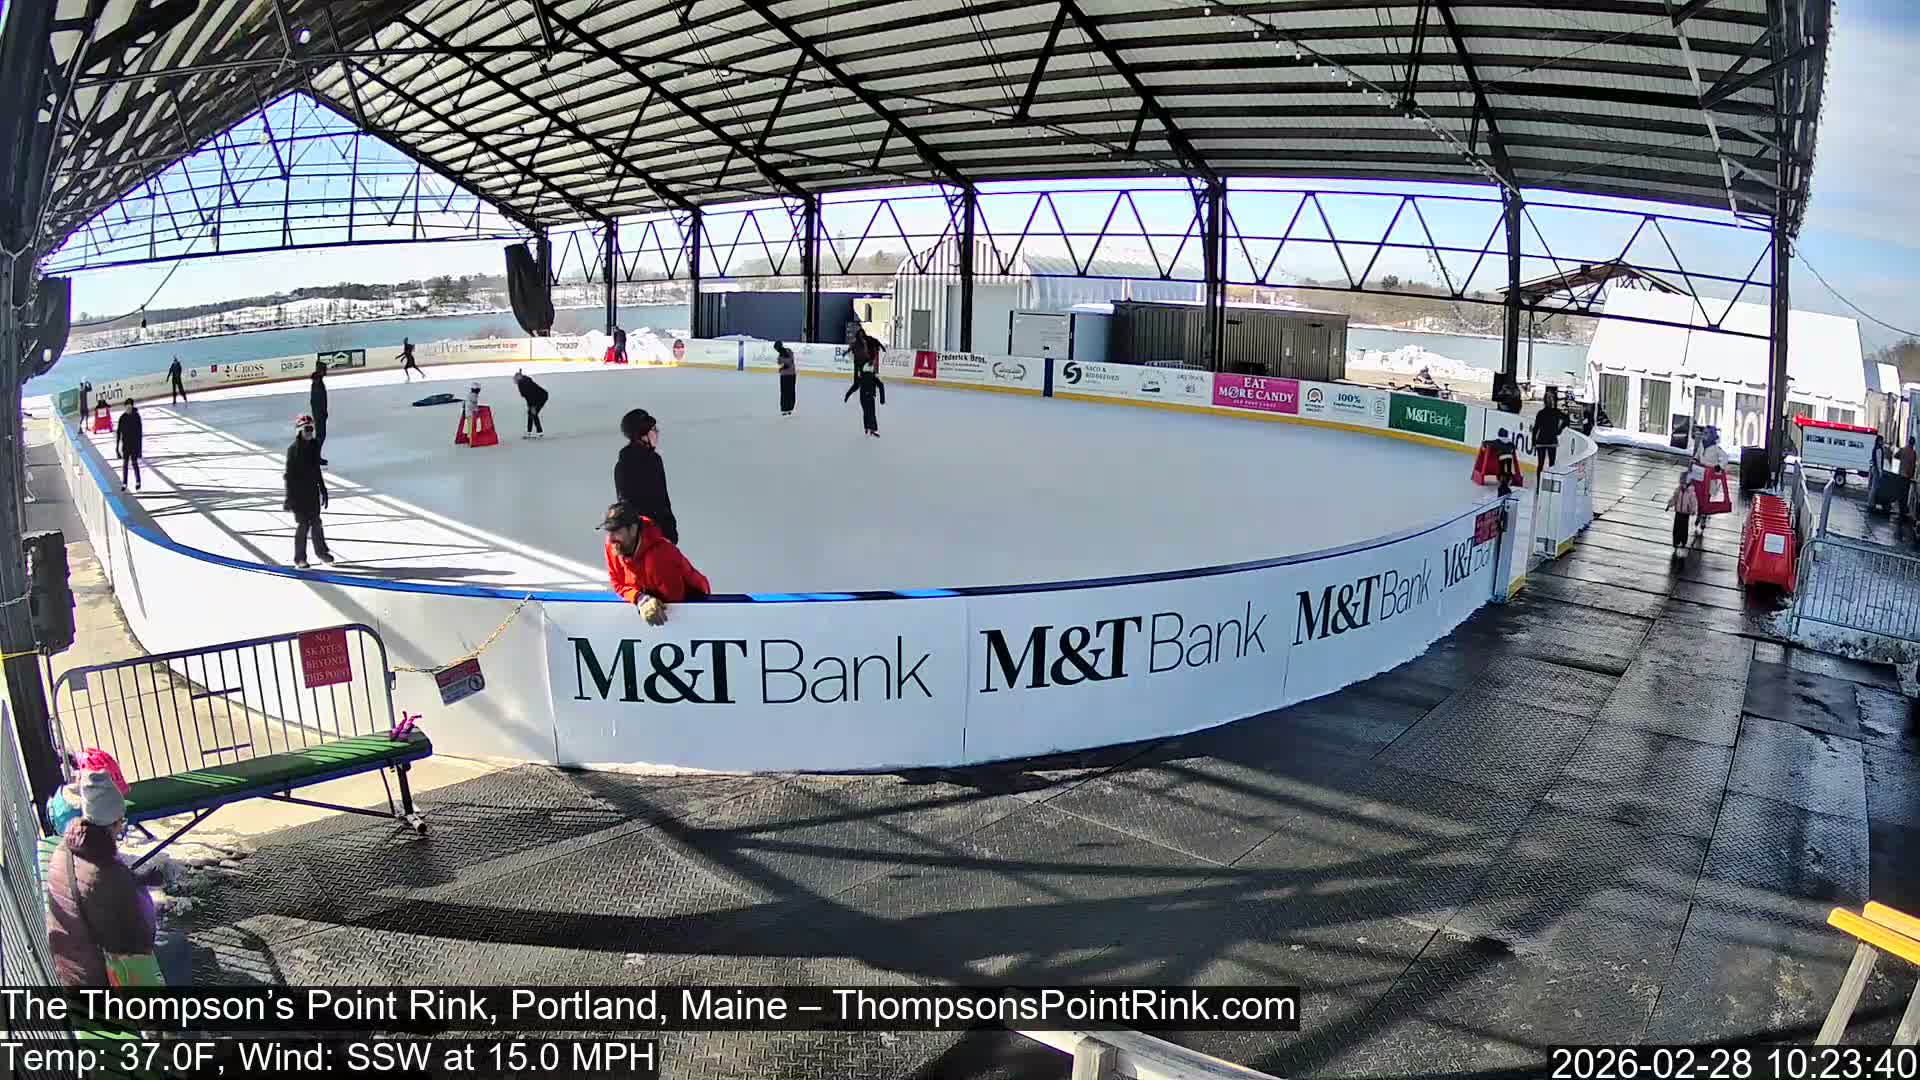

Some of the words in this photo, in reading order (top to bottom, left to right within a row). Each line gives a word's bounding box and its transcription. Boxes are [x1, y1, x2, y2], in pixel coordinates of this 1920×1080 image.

[938, 353, 968, 362] Frederick
[1244, 377, 1266, 390] EAT
[1219, 386, 1254, 399] MORE
[1256, 390, 1294, 403] CANDY
[1338, 393, 1361, 404] 100%
[1405, 406, 1430, 424] M&T
[1429, 410, 1451, 427] Bank
[1440, 535, 1475, 592] M&T
[1292, 574, 1381, 646] M&T
[1380, 559, 1432, 621] Bank
[315, 633, 330, 642] NO
[980, 616, 1143, 693] M&T
[1148, 599, 1268, 674] Bank
[305, 643, 343, 656] SKATES
[568, 637, 748, 704] M&T
[760, 635, 933, 704] Bank
